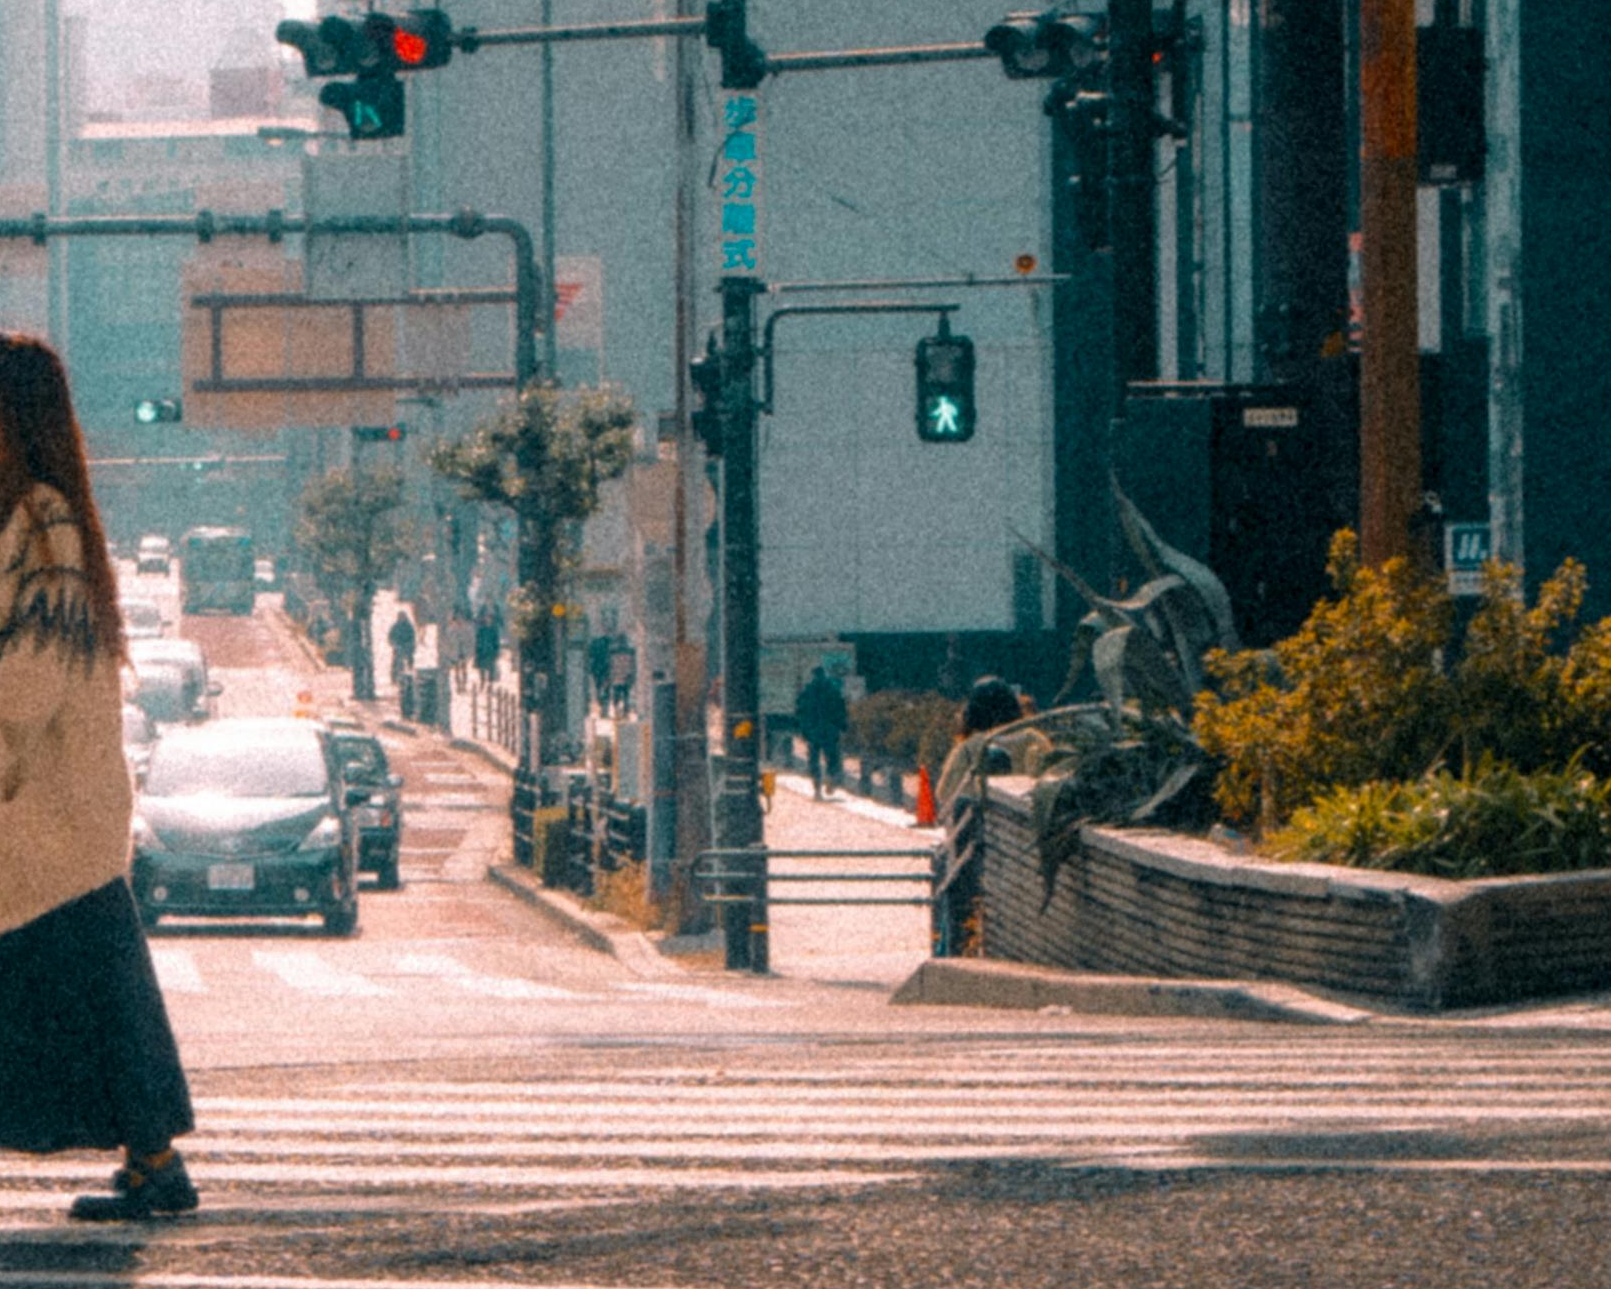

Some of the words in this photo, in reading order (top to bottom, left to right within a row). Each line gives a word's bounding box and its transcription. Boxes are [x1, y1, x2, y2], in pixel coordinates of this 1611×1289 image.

[722, 95, 758, 271] 歩車分離式
